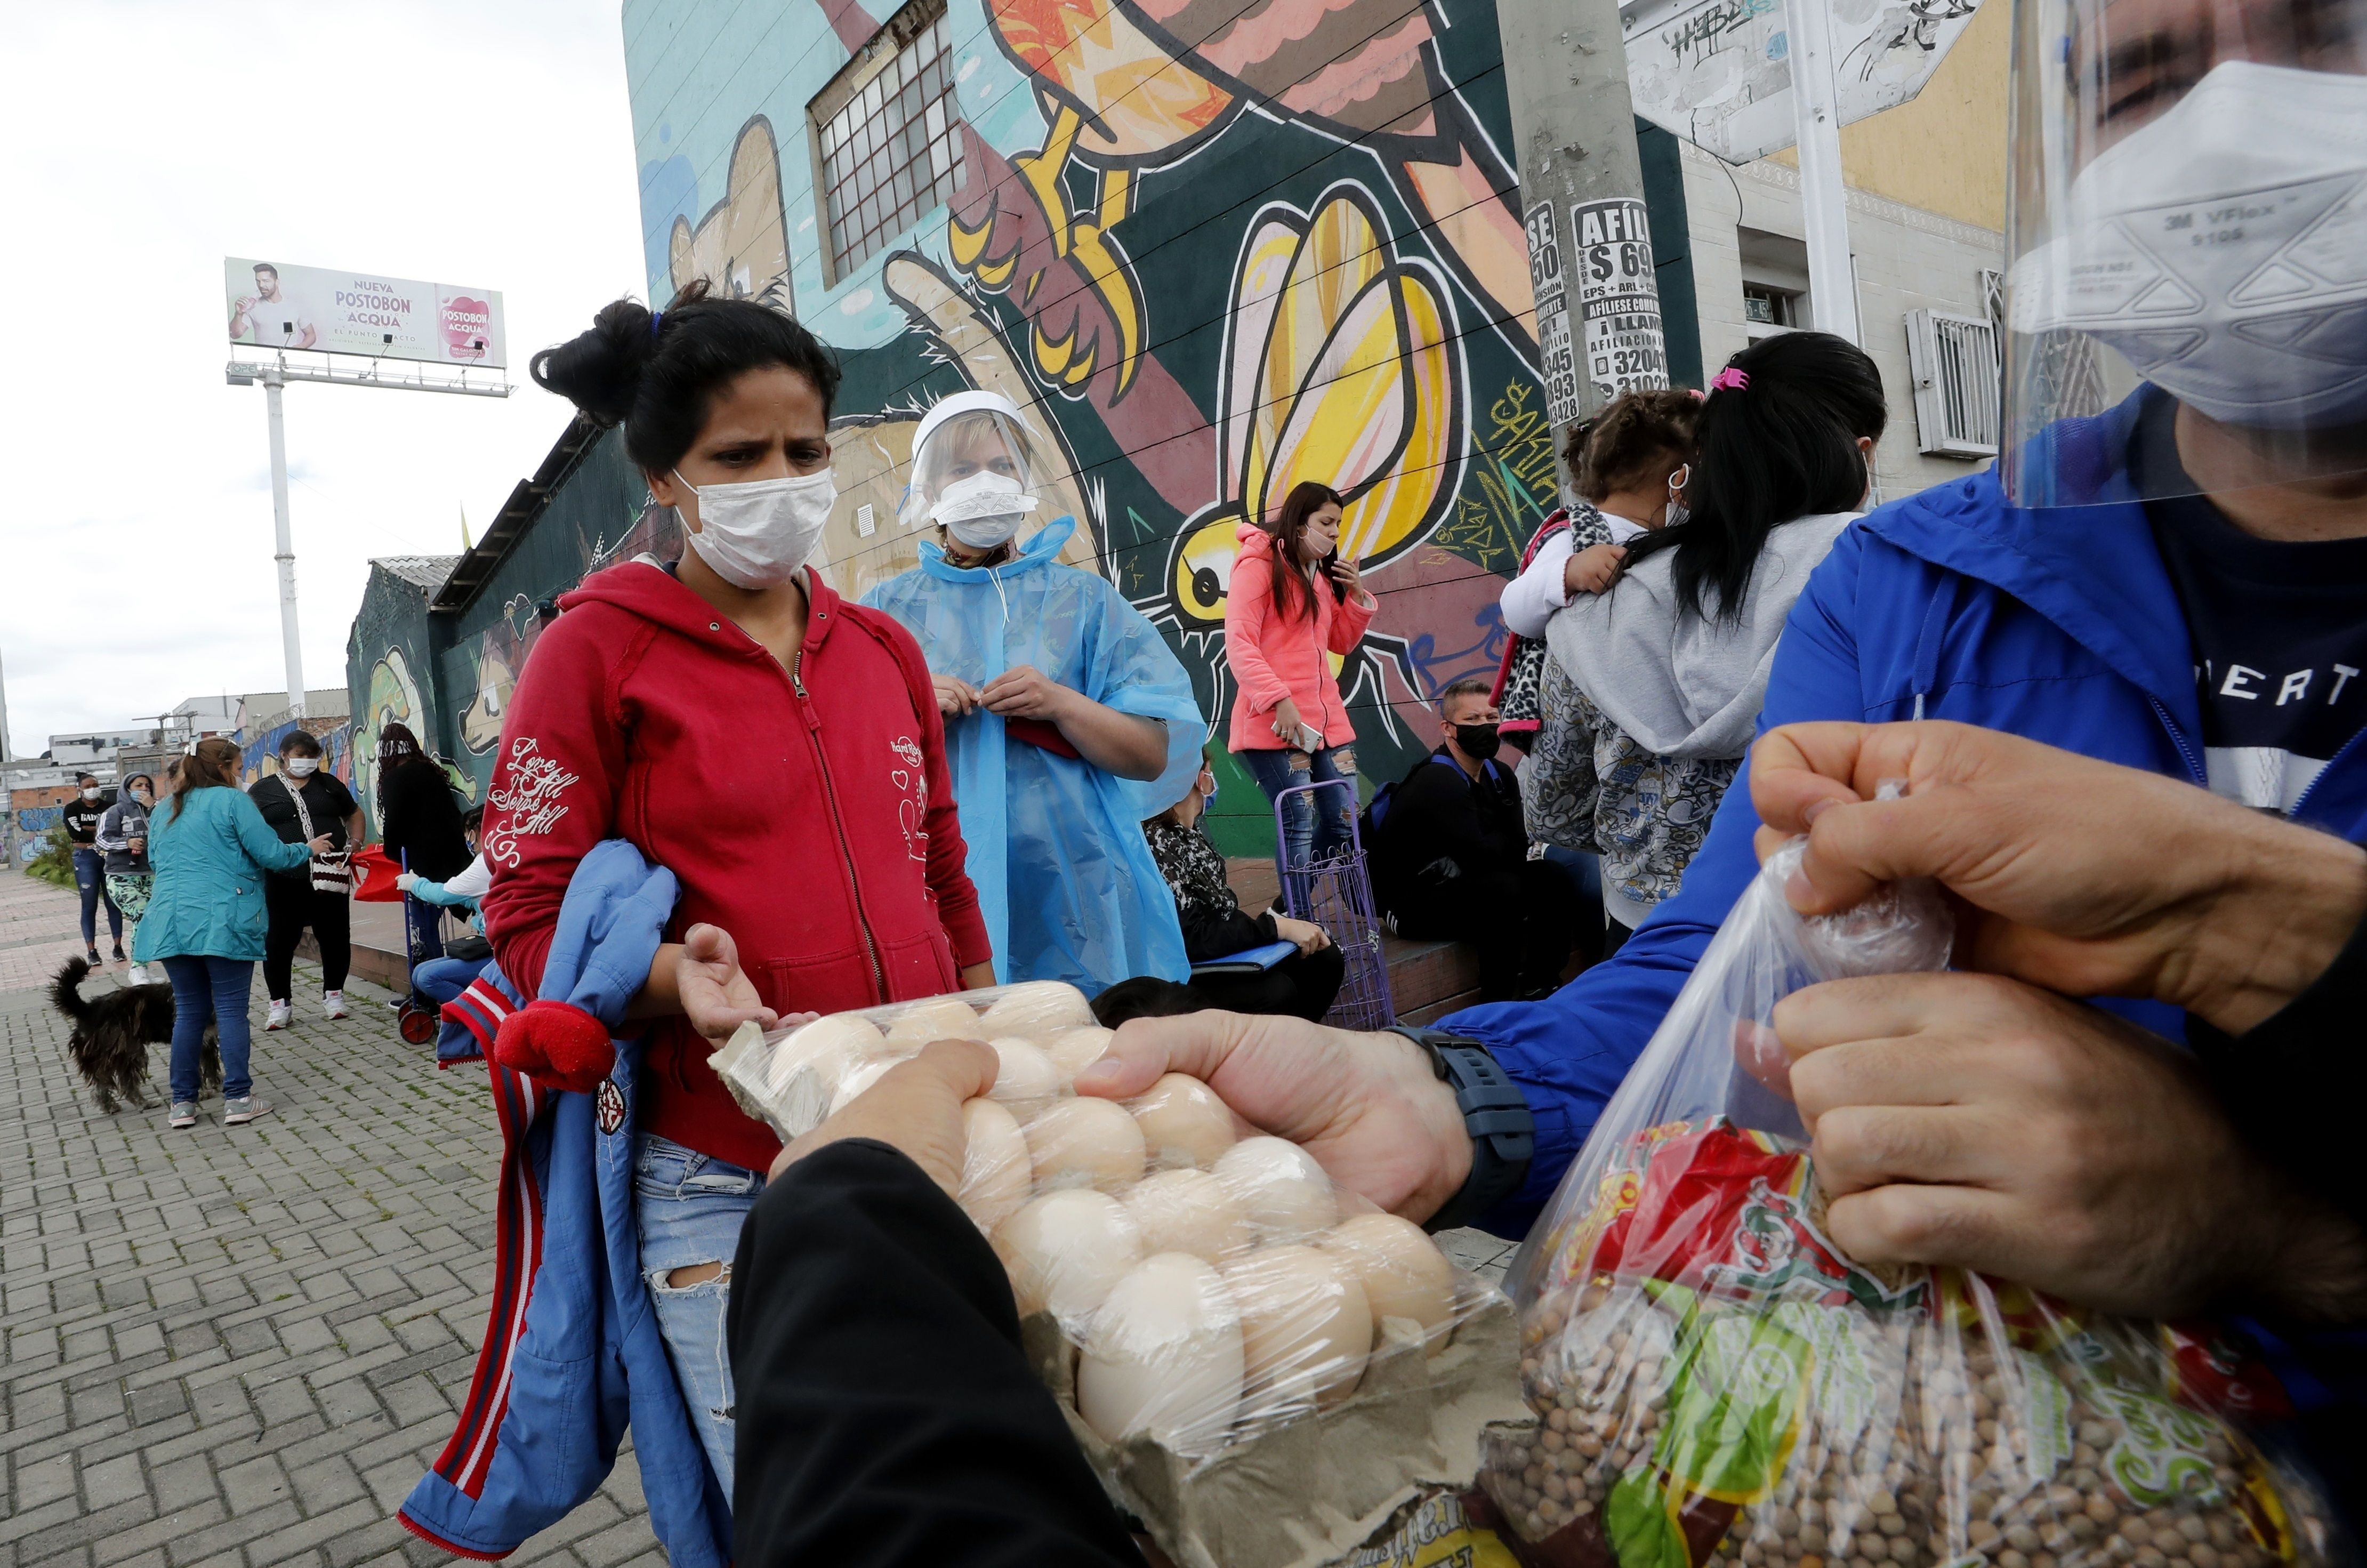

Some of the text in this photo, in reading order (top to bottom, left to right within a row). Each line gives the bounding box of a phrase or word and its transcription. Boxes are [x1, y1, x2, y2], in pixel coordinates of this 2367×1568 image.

[1589, 245, 1613, 282] $
[354, 280, 394, 294] NUEVA
[1583, 286, 1606, 299] EPS
[1619, 283, 1638, 293] ARL
[335, 291, 410, 313] POSTOBON
[1589, 298, 1632, 318] AFÍLIESE
[1633, 298, 1653, 312] COMO
[348, 312, 401, 327] ACQUA
[442, 310, 487, 324] POSTOBON
[449, 324, 482, 333] ACQUA
[1590, 333, 1657, 353] AFILIACIÓN
[1614, 350, 1669, 375] 32041
[1617, 375, 1670, 395] 31021
[506, 737, 557, 777] Love
[890, 741, 908, 753] Hard
[487, 773, 541, 811] Serve
